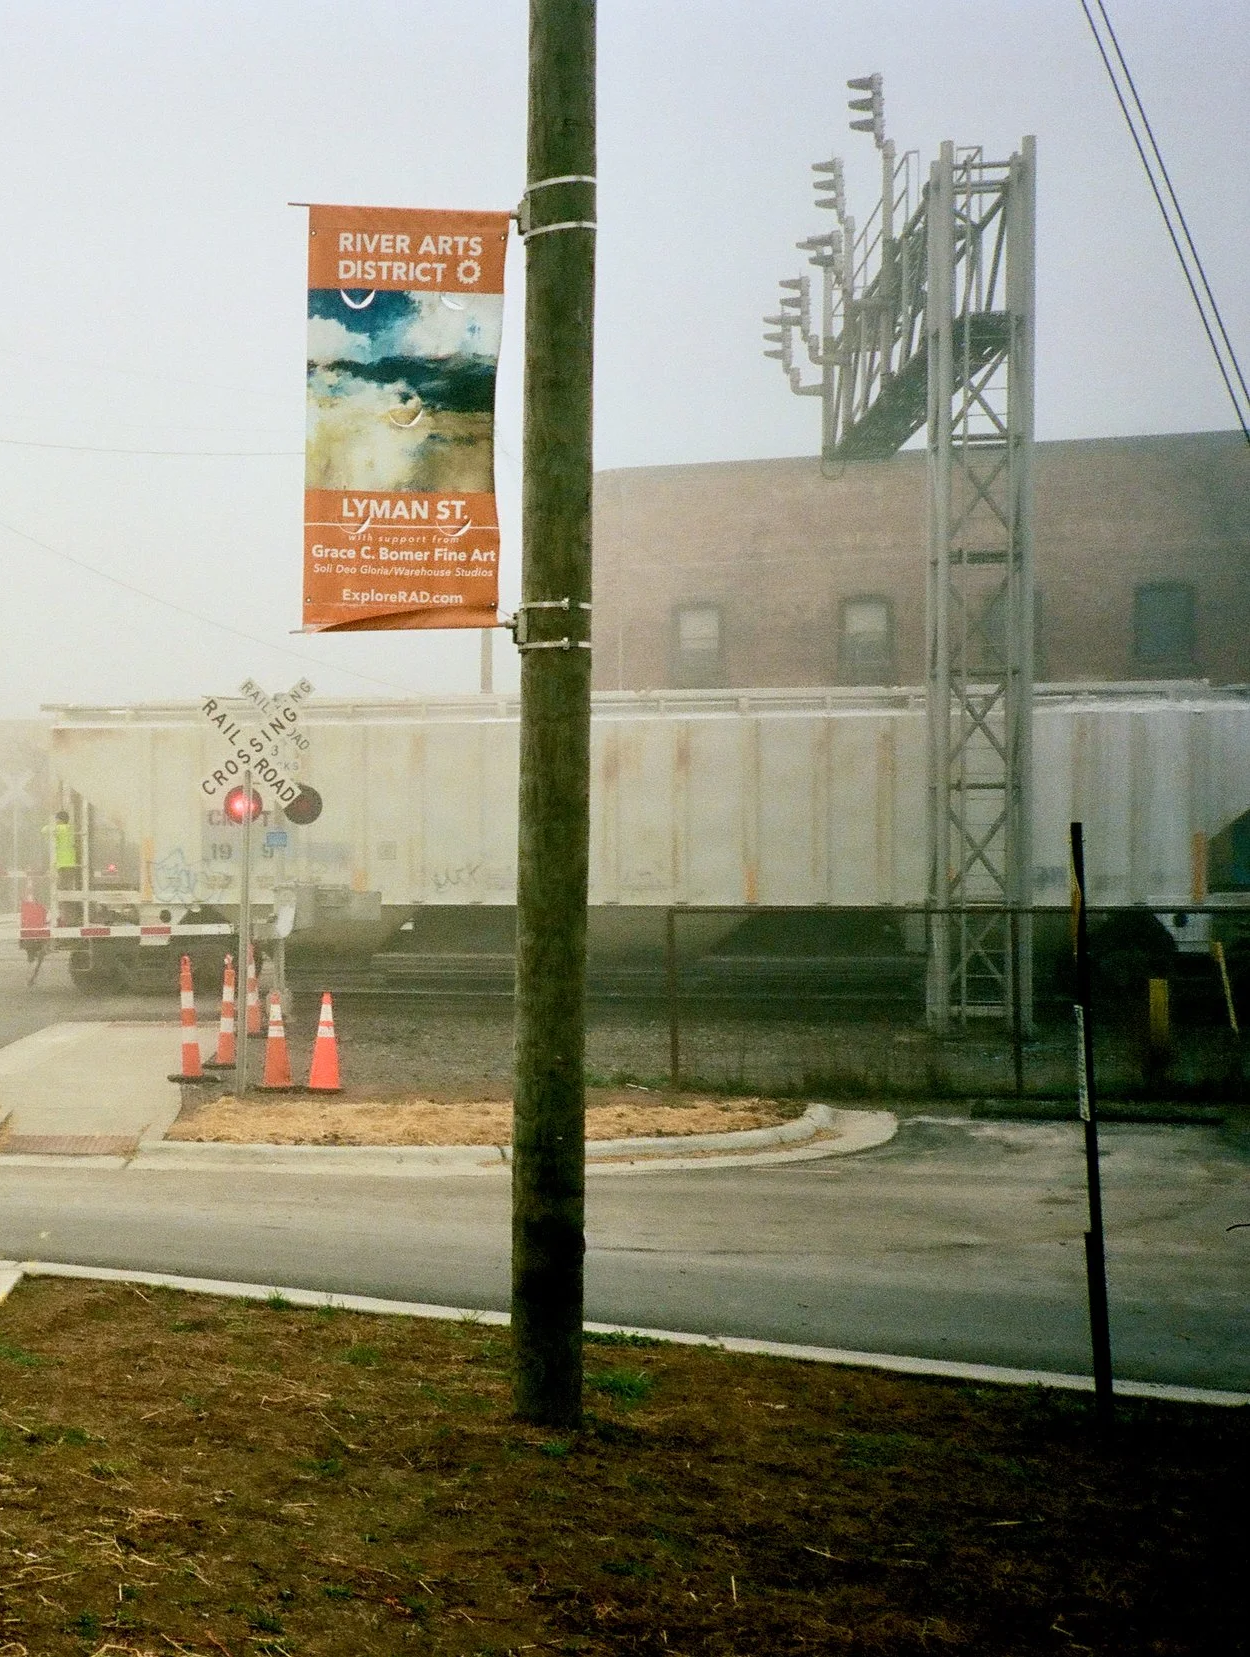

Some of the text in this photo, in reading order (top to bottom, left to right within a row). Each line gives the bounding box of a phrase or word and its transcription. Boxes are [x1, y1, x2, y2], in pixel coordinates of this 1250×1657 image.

[338, 232, 483, 257] RIVER ARTS
[338, 259, 447, 283] DISTRICT
[342, 497, 468, 520] LYMAN ST.
[348, 532, 460, 545] with support from
[311, 544, 496, 562] Grace C. Bomer Fine Art
[313, 563, 332, 573] Soli
[336, 564, 357, 574] Deo
[455, 566, 493, 577] Studios
[342, 588, 463, 604] ExploreRAD.com
[201, 706, 298, 795] CROSSING
